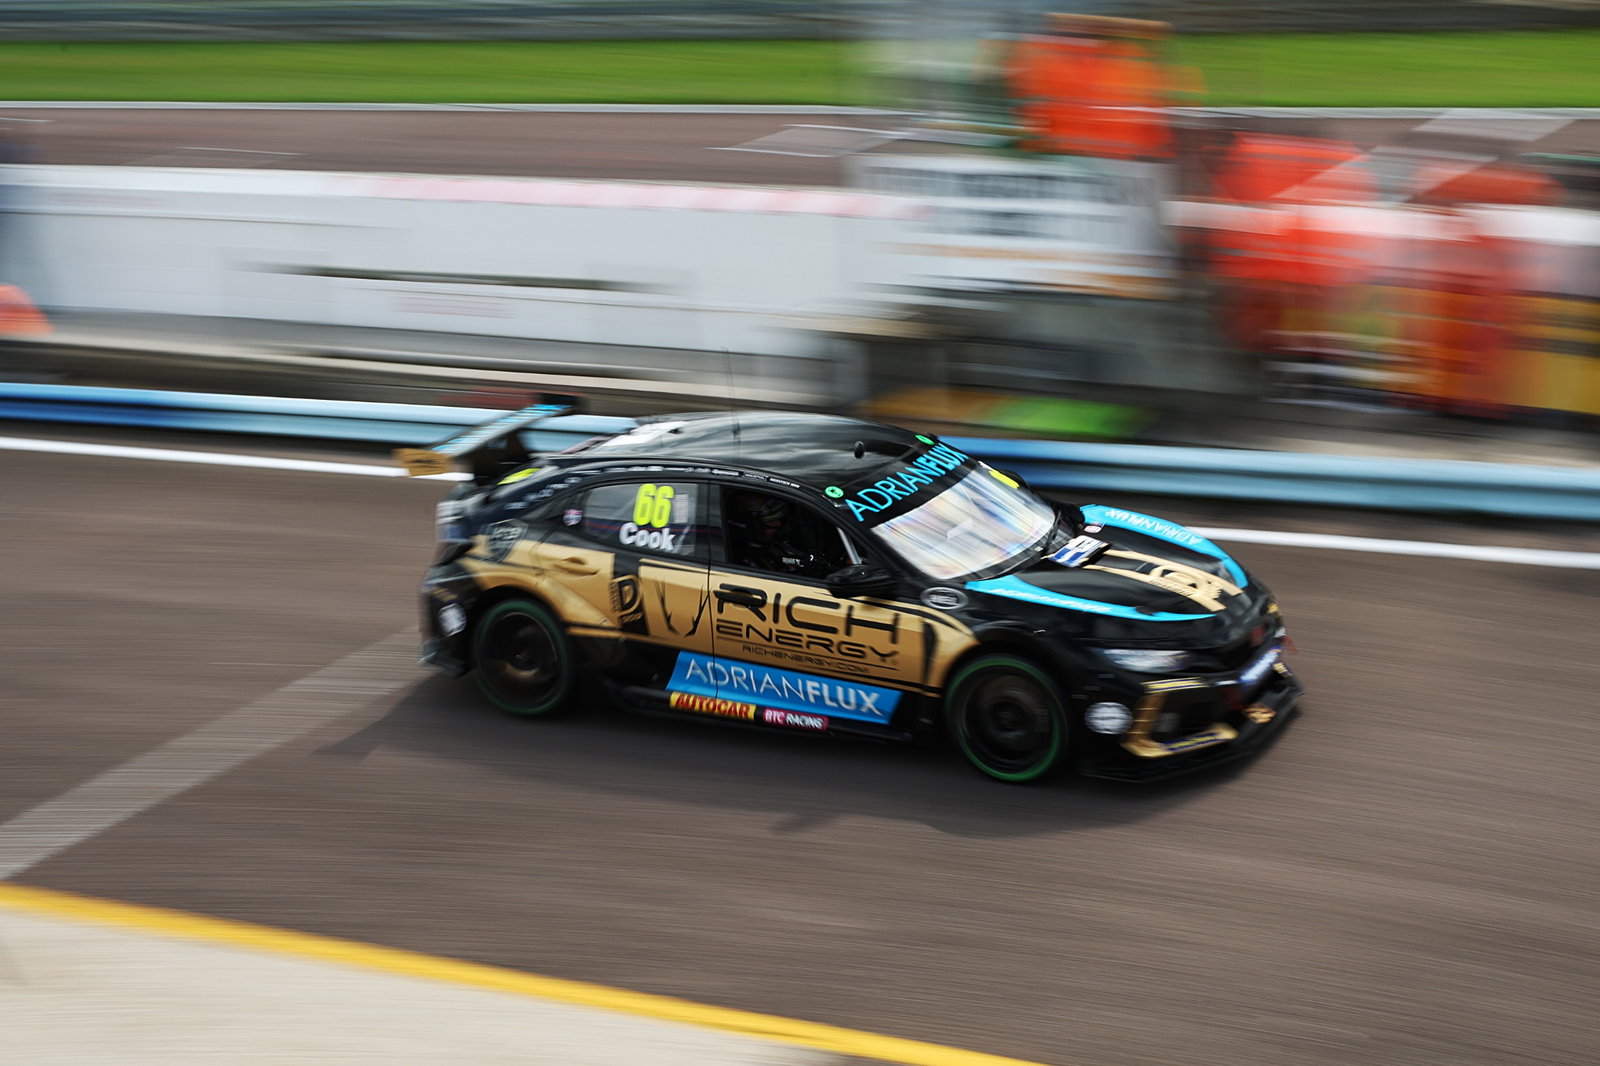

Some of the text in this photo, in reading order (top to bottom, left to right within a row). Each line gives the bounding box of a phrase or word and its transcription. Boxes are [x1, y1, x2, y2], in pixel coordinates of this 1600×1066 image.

[845, 443, 969, 522] ADRIANFLUX
[633, 483, 675, 528] 66
[619, 522, 676, 551] Cook
[713, 583, 899, 645] RICH
[716, 618, 899, 664] ENERGY
[674, 693, 752, 719] AUTOCAR
[685, 658, 884, 717] ADRIANFLUX
[786, 712, 824, 729] RACING
